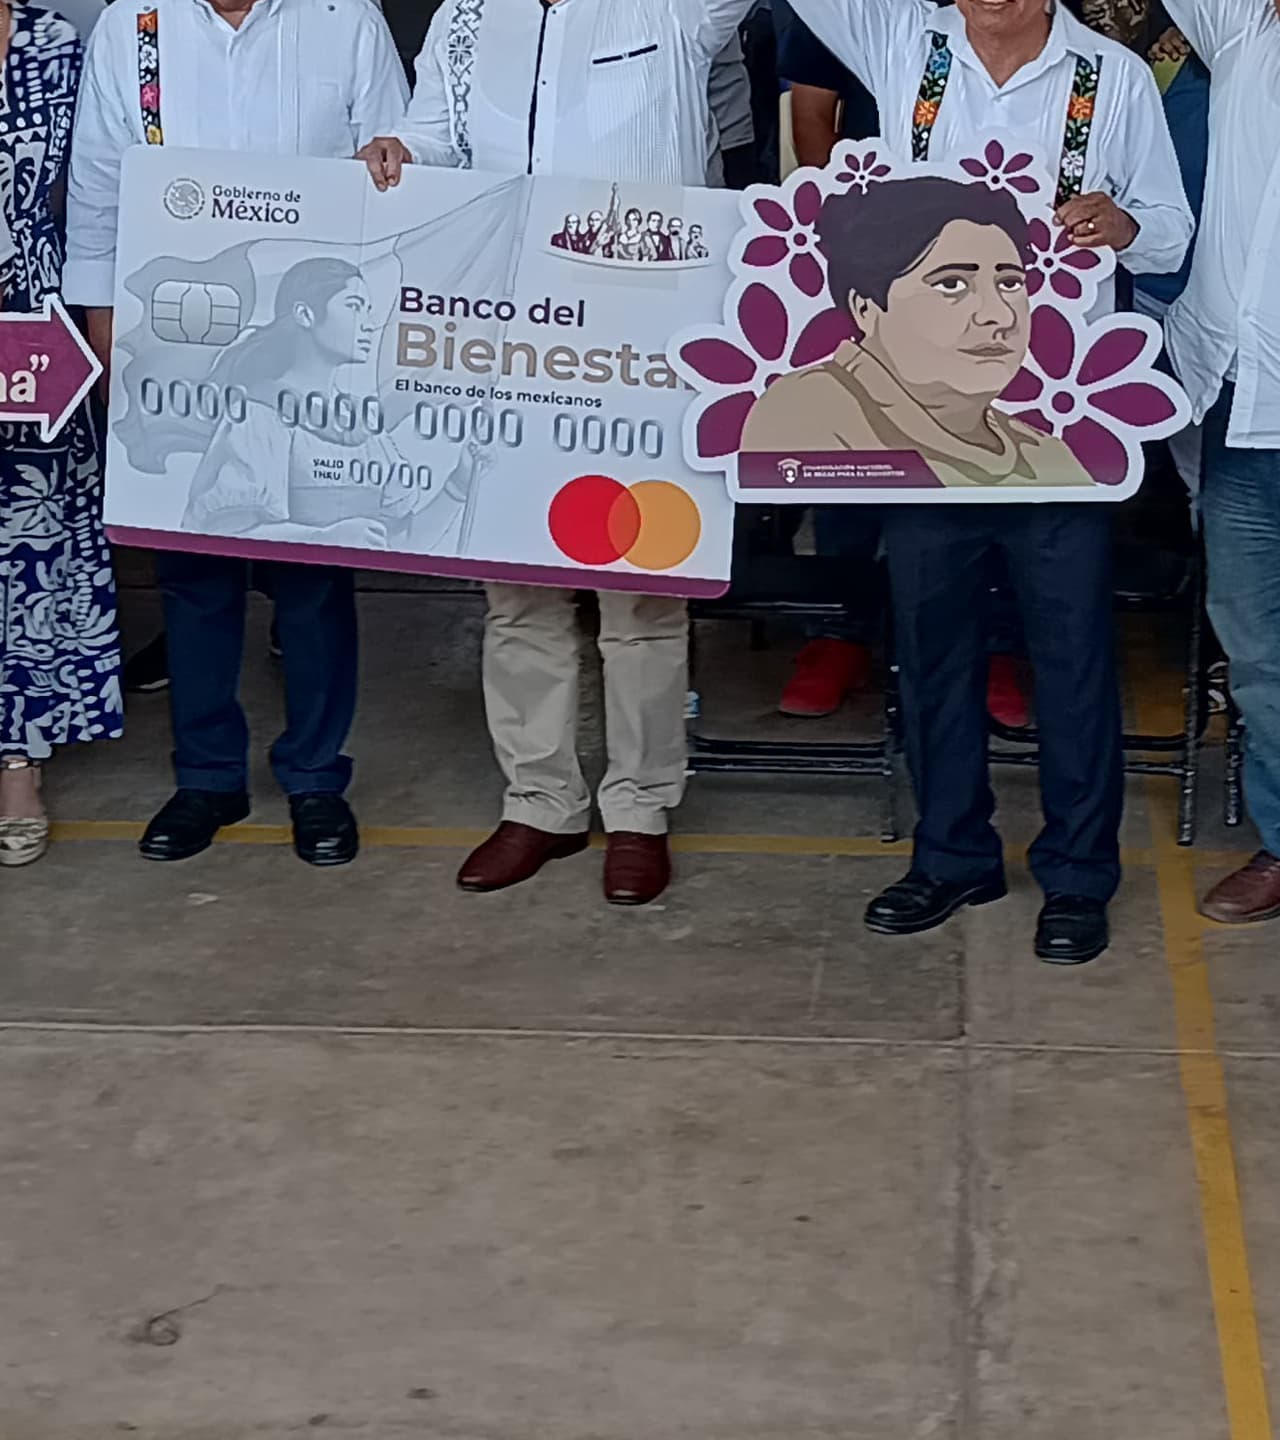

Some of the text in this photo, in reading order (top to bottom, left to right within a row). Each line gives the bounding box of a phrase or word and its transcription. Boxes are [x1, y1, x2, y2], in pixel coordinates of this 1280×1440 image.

[212, 184, 301, 203] Gobierno de
[211, 197, 300, 225] México
[399, 286, 585, 327] Banco del
[396, 321, 697, 392] Bienesta
[395, 378, 603, 409] El banco de los mexicanos
[141, 377, 664, 460] 0000 0000 0000 0000
[313, 458, 344, 469] VALID
[313, 470, 341, 481] THRU
[349, 458, 432, 491] 00/00
